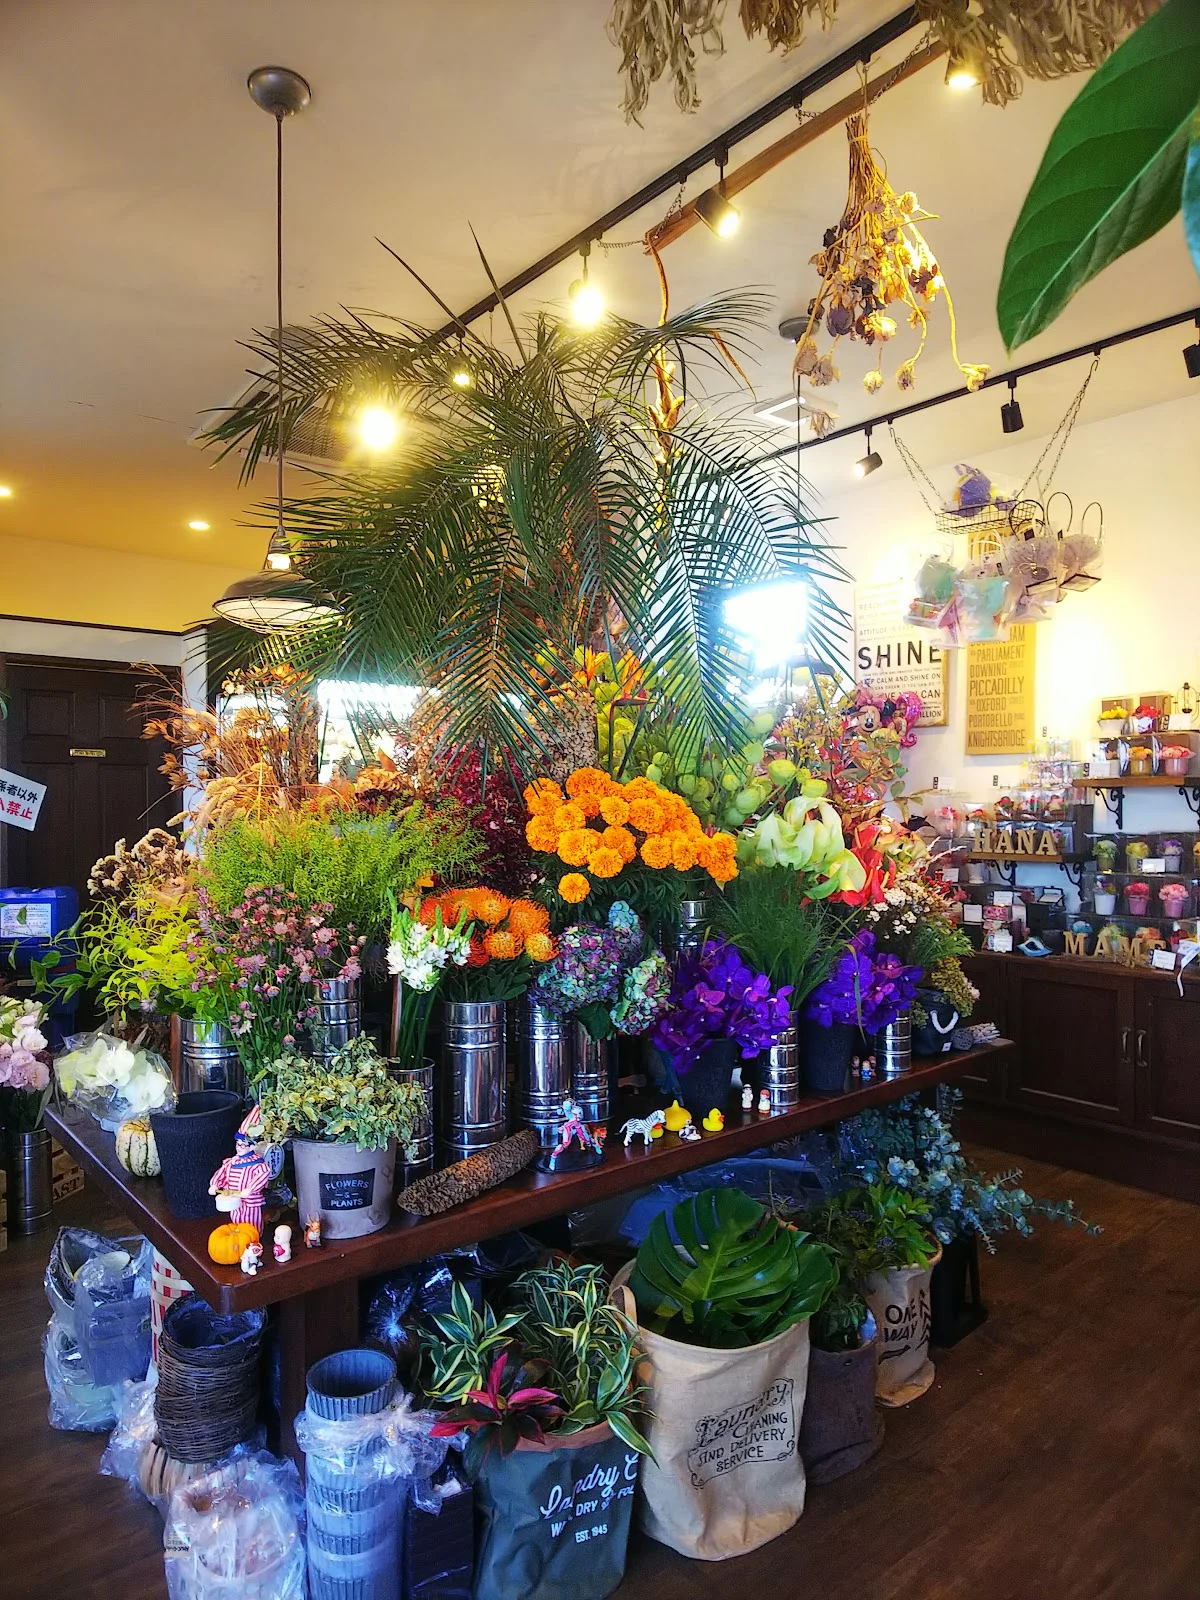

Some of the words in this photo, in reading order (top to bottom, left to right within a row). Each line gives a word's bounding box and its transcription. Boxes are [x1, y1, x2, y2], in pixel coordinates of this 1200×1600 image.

[859, 627, 887, 637] ATTITUDE
[858, 641, 942, 670] SHINE
[976, 645, 1026, 662] PARLIAMENT
[970, 662, 1007, 678] DOWNING
[921, 689, 941, 699] CAN
[969, 676, 1025, 697] PICCADILLY
[976, 697, 1006, 711] OXFORD
[919, 711, 942, 719] ILLION
[969, 713, 1013, 728] PORTOBELLO
[967, 729, 1026, 748] KNIGHTSBRIDGE
[972, 828, 1057, 856] HANA
[325, 1179, 369, 1191] FLOWERS
[330, 1198, 363, 1208] PLANTS
[885, 1299, 917, 1324] ONE
[883, 1321, 918, 1342] WAY
[698, 1447, 724, 1468] AND
[730, 1428, 786, 1453] DELIVERY
[716, 1446, 764, 1472] SERVICE
[576, 1499, 598, 1517] DRY
[575, 1529, 591, 1543] EST.
[592, 1523, 608, 1537] 1945
